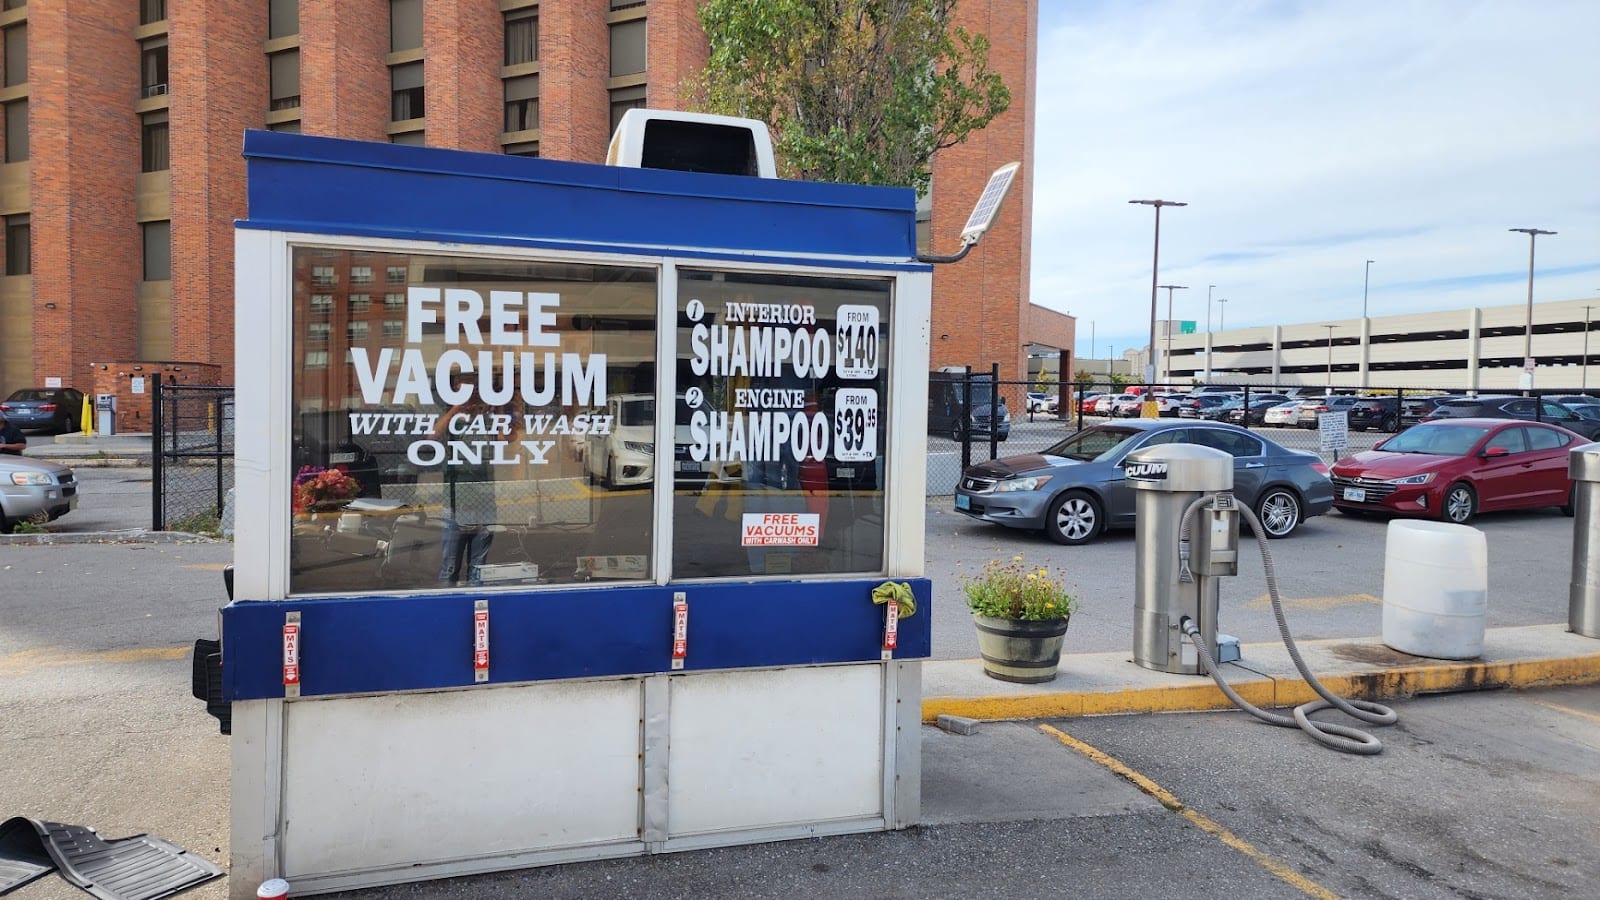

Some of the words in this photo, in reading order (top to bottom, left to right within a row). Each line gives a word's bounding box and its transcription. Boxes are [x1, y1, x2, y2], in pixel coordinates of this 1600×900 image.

[407, 286, 560, 347] FREE
[725, 302, 816, 325] INTERIOR
[847, 312, 869, 323] FROM
[690, 323, 831, 379] SHAMPOO
[838, 324, 876, 369] $140
[350, 347, 607, 407] VACUUM
[735, 388, 805, 409] ENGINE
[845, 395, 868, 405] FROM
[349, 413, 439, 436] WITH
[448, 414, 512, 436] CAR
[523, 414, 613, 436] WASH
[689, 410, 829, 462] SHAMPOO
[407, 440, 556, 466] ONLY
[1125, 462, 1168, 477] CUUM
[746, 525, 816, 536] VACUUMS
[763, 514, 799, 525] FREE
[889, 606, 897, 630] MATS
[478, 621, 486, 649] MATS
[286, 634, 295, 663] MATS
